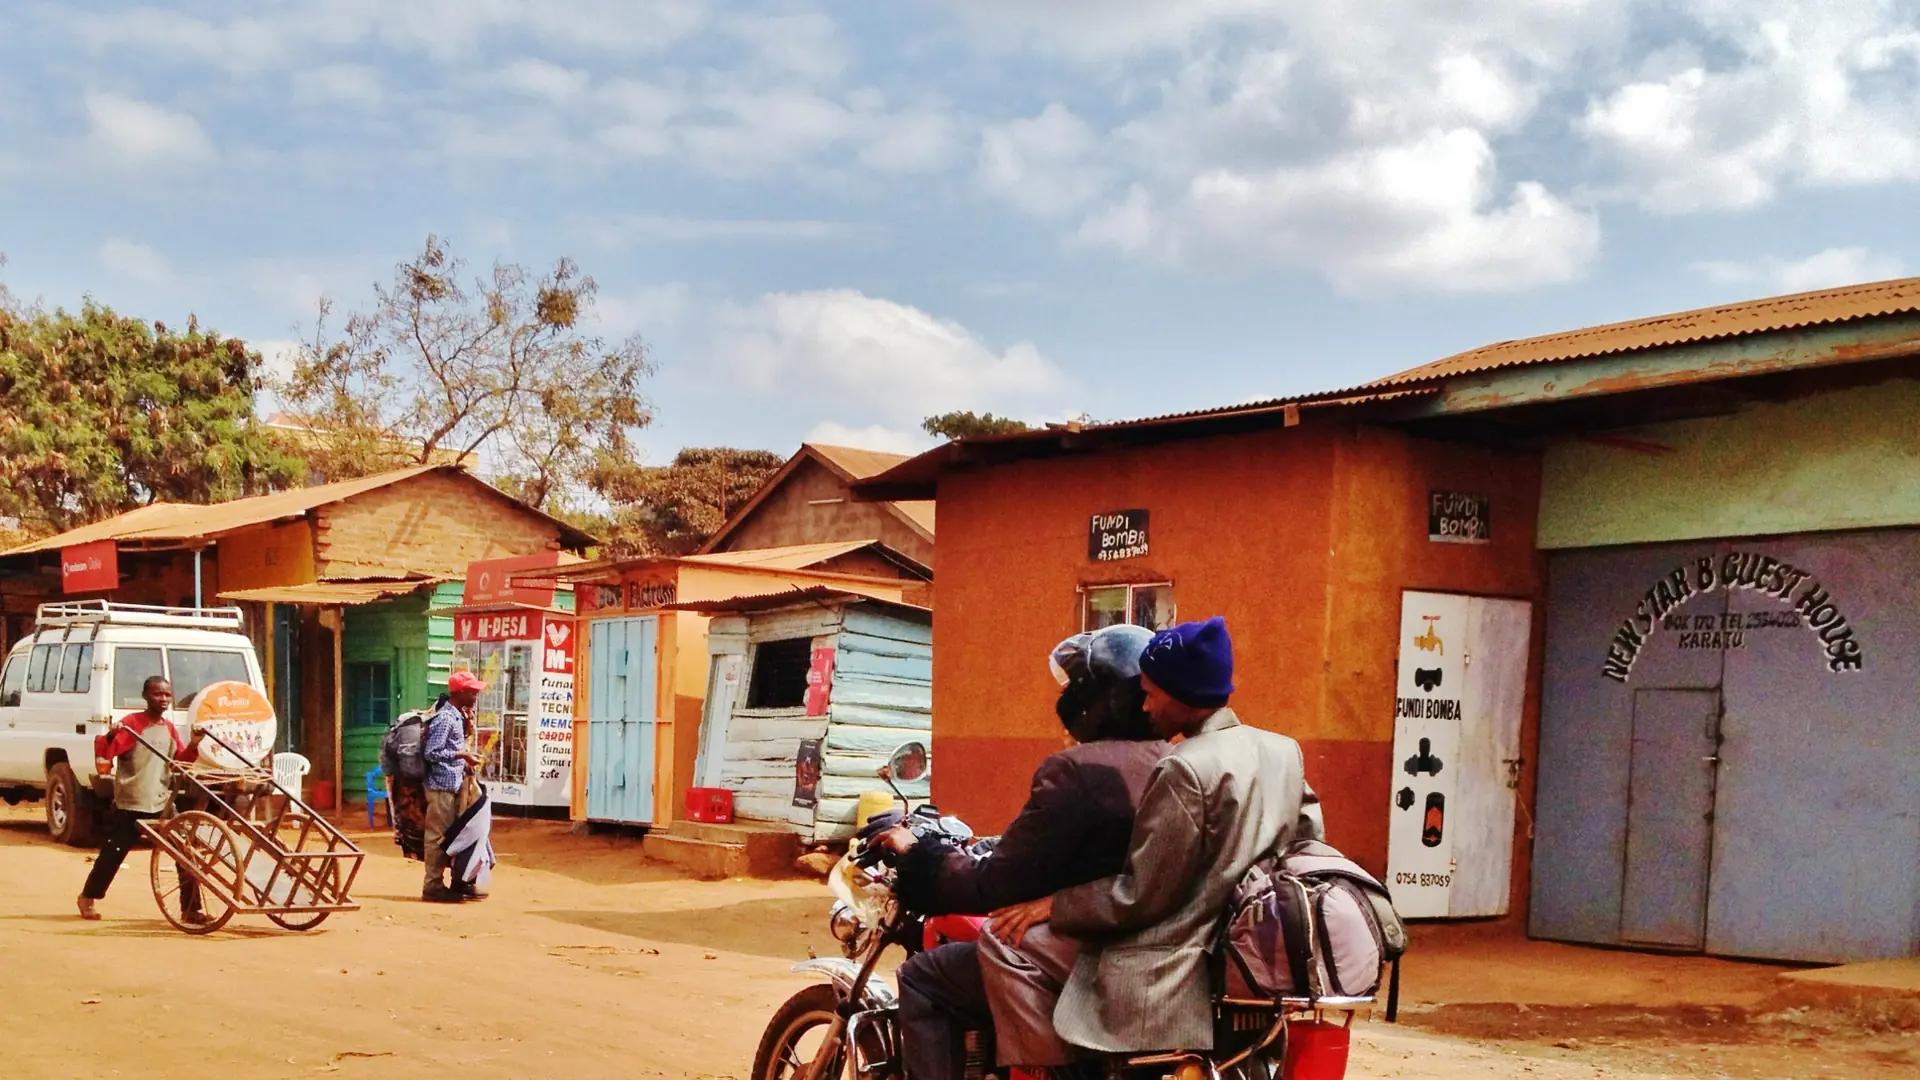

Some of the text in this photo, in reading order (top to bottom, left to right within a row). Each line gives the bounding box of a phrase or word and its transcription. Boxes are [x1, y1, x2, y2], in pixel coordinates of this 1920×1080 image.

[1432, 494, 1479, 517] FUNDI
[1092, 514, 1129, 534] FUNDI
[1440, 516, 1488, 540] BOMBA
[1102, 529, 1146, 548] BOMBA
[1602, 617, 1647, 684] NEW
[1637, 566, 1698, 636] STAR
[1721, 551, 1812, 603] GUEST
[1795, 582, 1863, 673] HOUSE
[1395, 697, 1462, 721] FUNDI BOMBA
[540, 768, 560, 779] zote
[1395, 871, 1452, 888] 0754 837059
